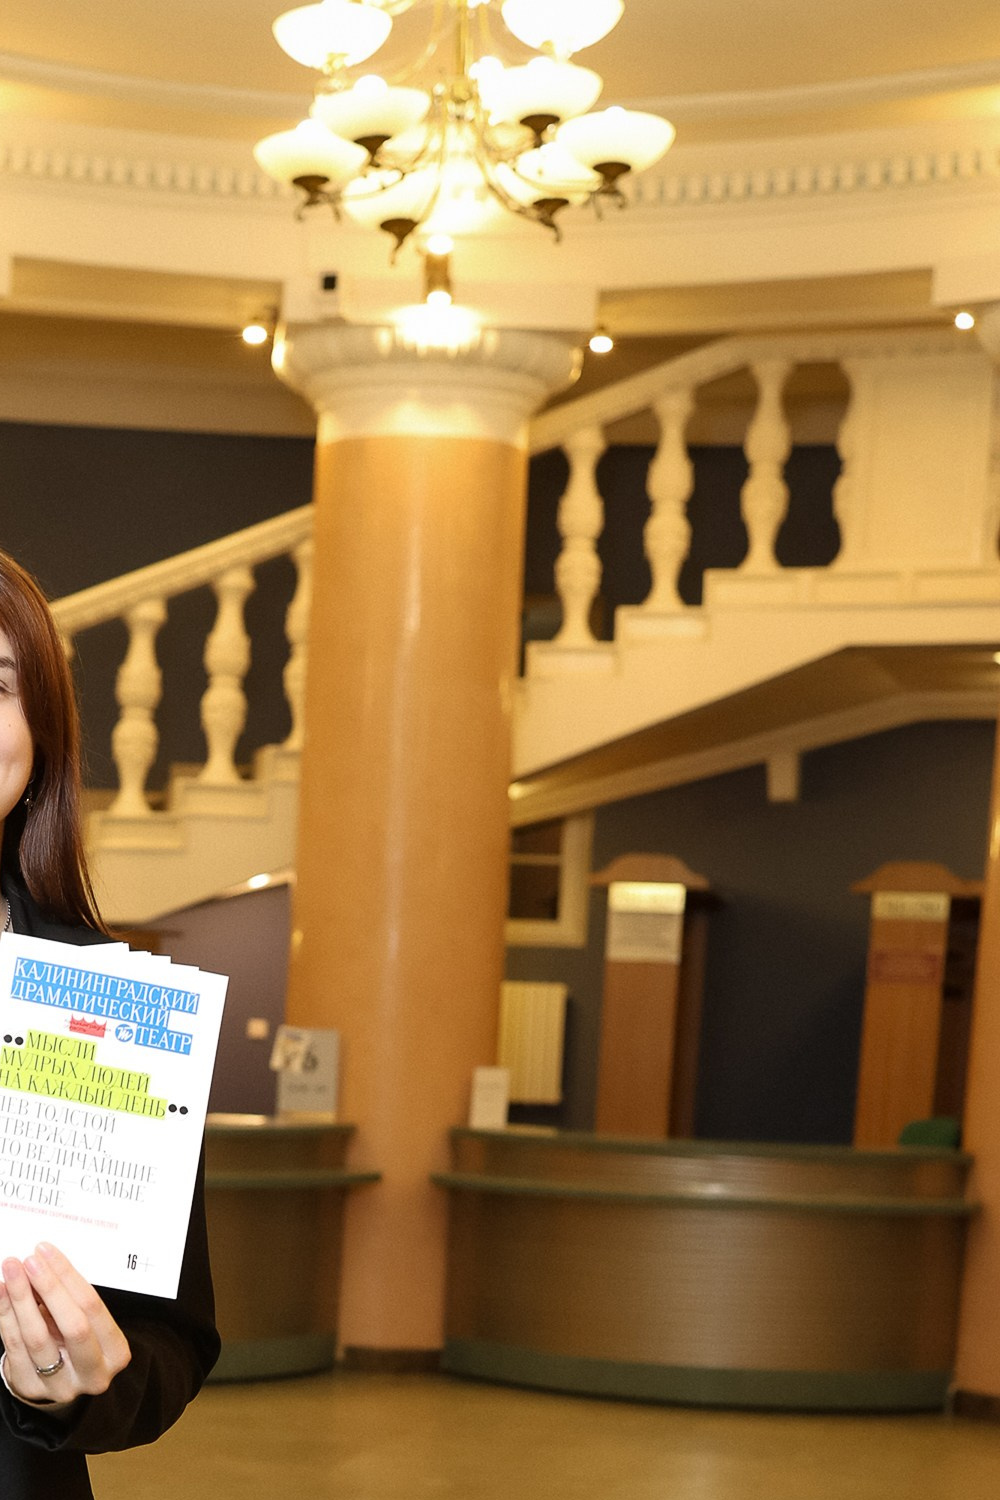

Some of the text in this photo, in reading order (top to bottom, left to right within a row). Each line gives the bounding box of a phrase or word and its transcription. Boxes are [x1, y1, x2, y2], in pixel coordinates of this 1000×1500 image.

[11, 980, 170, 1027] ДРАМАТИЧЕСКИЙ
[15, 959, 199, 1013] КАЛИНИНГРАДСКИЙ
[28, 1032, 96, 1061] МЫСЛИ
[137, 1027, 192, 1053] ТЕАТР
[2, 1049, 150, 1093] МУДРЫХ ЛЮДЕЙ
[27, 1075, 113, 1107] КАЖДЫЙ
[116, 1093, 167, 1118] ДЕНЬ
[34, 1101, 116, 1134] ТОЛСТОЙ
[26, 1142, 158, 1185] ВЕЛИЧАЙШИЕ
[80, 1175, 147, 1203] САМЫЕ
